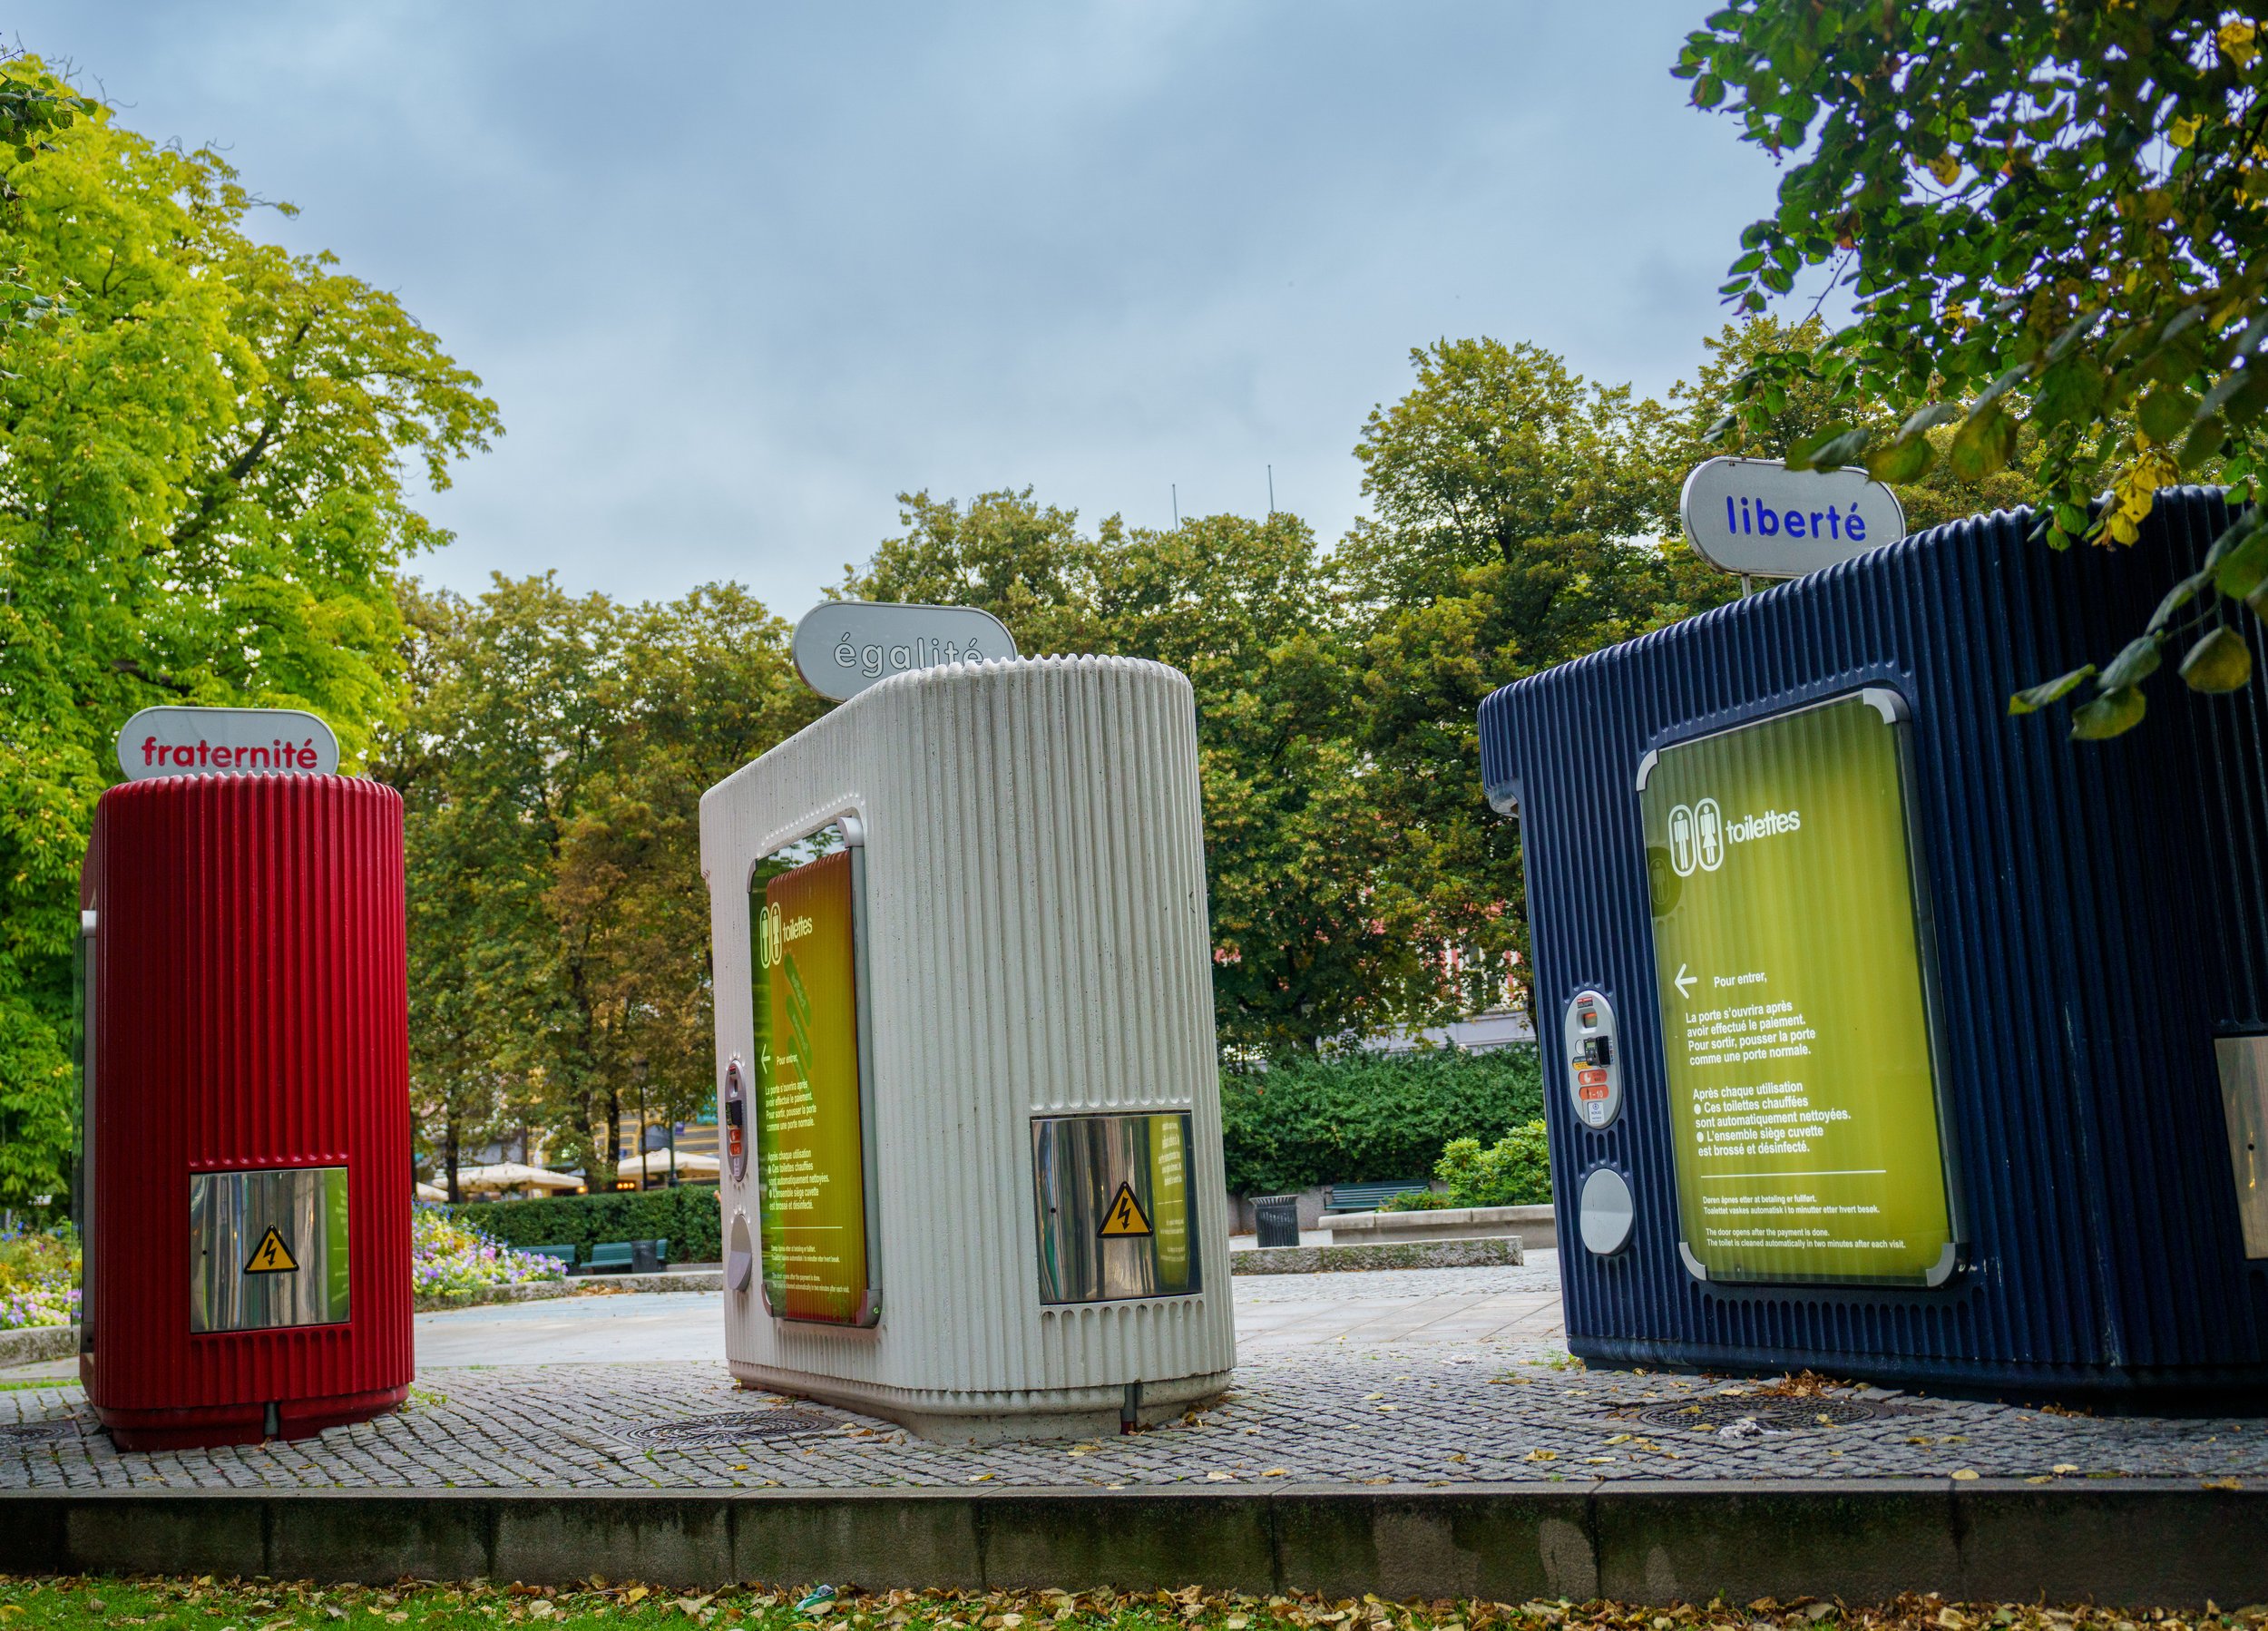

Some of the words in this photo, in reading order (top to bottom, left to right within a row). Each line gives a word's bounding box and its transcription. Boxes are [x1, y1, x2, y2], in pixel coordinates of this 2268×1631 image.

[1726, 495, 1866, 542] liberté
[834, 631, 984, 679] égalité
[141, 736, 318, 769] fraternité
[1725, 809, 1801, 845] toilettes
[782, 915, 813, 943] toilettes
[1714, 976, 1735, 987] Pour
[1738, 972, 1767, 984] entrer,
[1686, 1012, 1697, 1024] La
[1699, 1010, 1721, 1025] porte
[1766, 1000, 1793, 1015] après
[1687, 1025, 1708, 1037] avoir
[1711, 1020, 1747, 1035] effectué
[1749, 1020, 1757, 1030] le
[1760, 1014, 1806, 1032] paiement.
[1688, 1040, 1708, 1051] Pour
[1711, 1036, 1737, 1050] sortir,
[1740, 1033, 1776, 1049] pousser
[1779, 1030, 1788, 1042] la
[1790, 1029, 1816, 1044] porte
[1690, 1053, 1721, 1066] comme
[1724, 1052, 1740, 1063] une
[1743, 1048, 1767, 1063] porte
[1769, 1044, 1811, 1059] normale.
[1693, 1087, 1719, 1102] Après
[1721, 1085, 1754, 1099] chaque
[1756, 1081, 1803, 1095] utilisation
[1704, 1101, 1721, 1113] Ces
[1723, 1099, 1760, 1112] toilettes
[1762, 1096, 1809, 1110] chauffées
[1696, 1116, 1715, 1128] sont
[1717, 1111, 1798, 1127] automatiquement
[1799, 1108, 1851, 1123] nettoyées.
[1760, 1126, 1785, 1141] siège
[1788, 1125, 1824, 1138] cuvette
[1698, 1145, 1712, 1157] est
[1714, 1143, 1744, 1156] brossé
[1747, 1143, 1756, 1154] et
[1758, 1140, 1810, 1154] désinfecté.
[1706, 1228, 1717, 1236] The
[1778, 1229, 1804, 1237] payment
[1765, 1240, 1806, 1249] automatically
[1854, 1239, 1870, 1248] after
[1871, 1240, 1887, 1248] each
[1889, 1240, 1906, 1248] visit.
